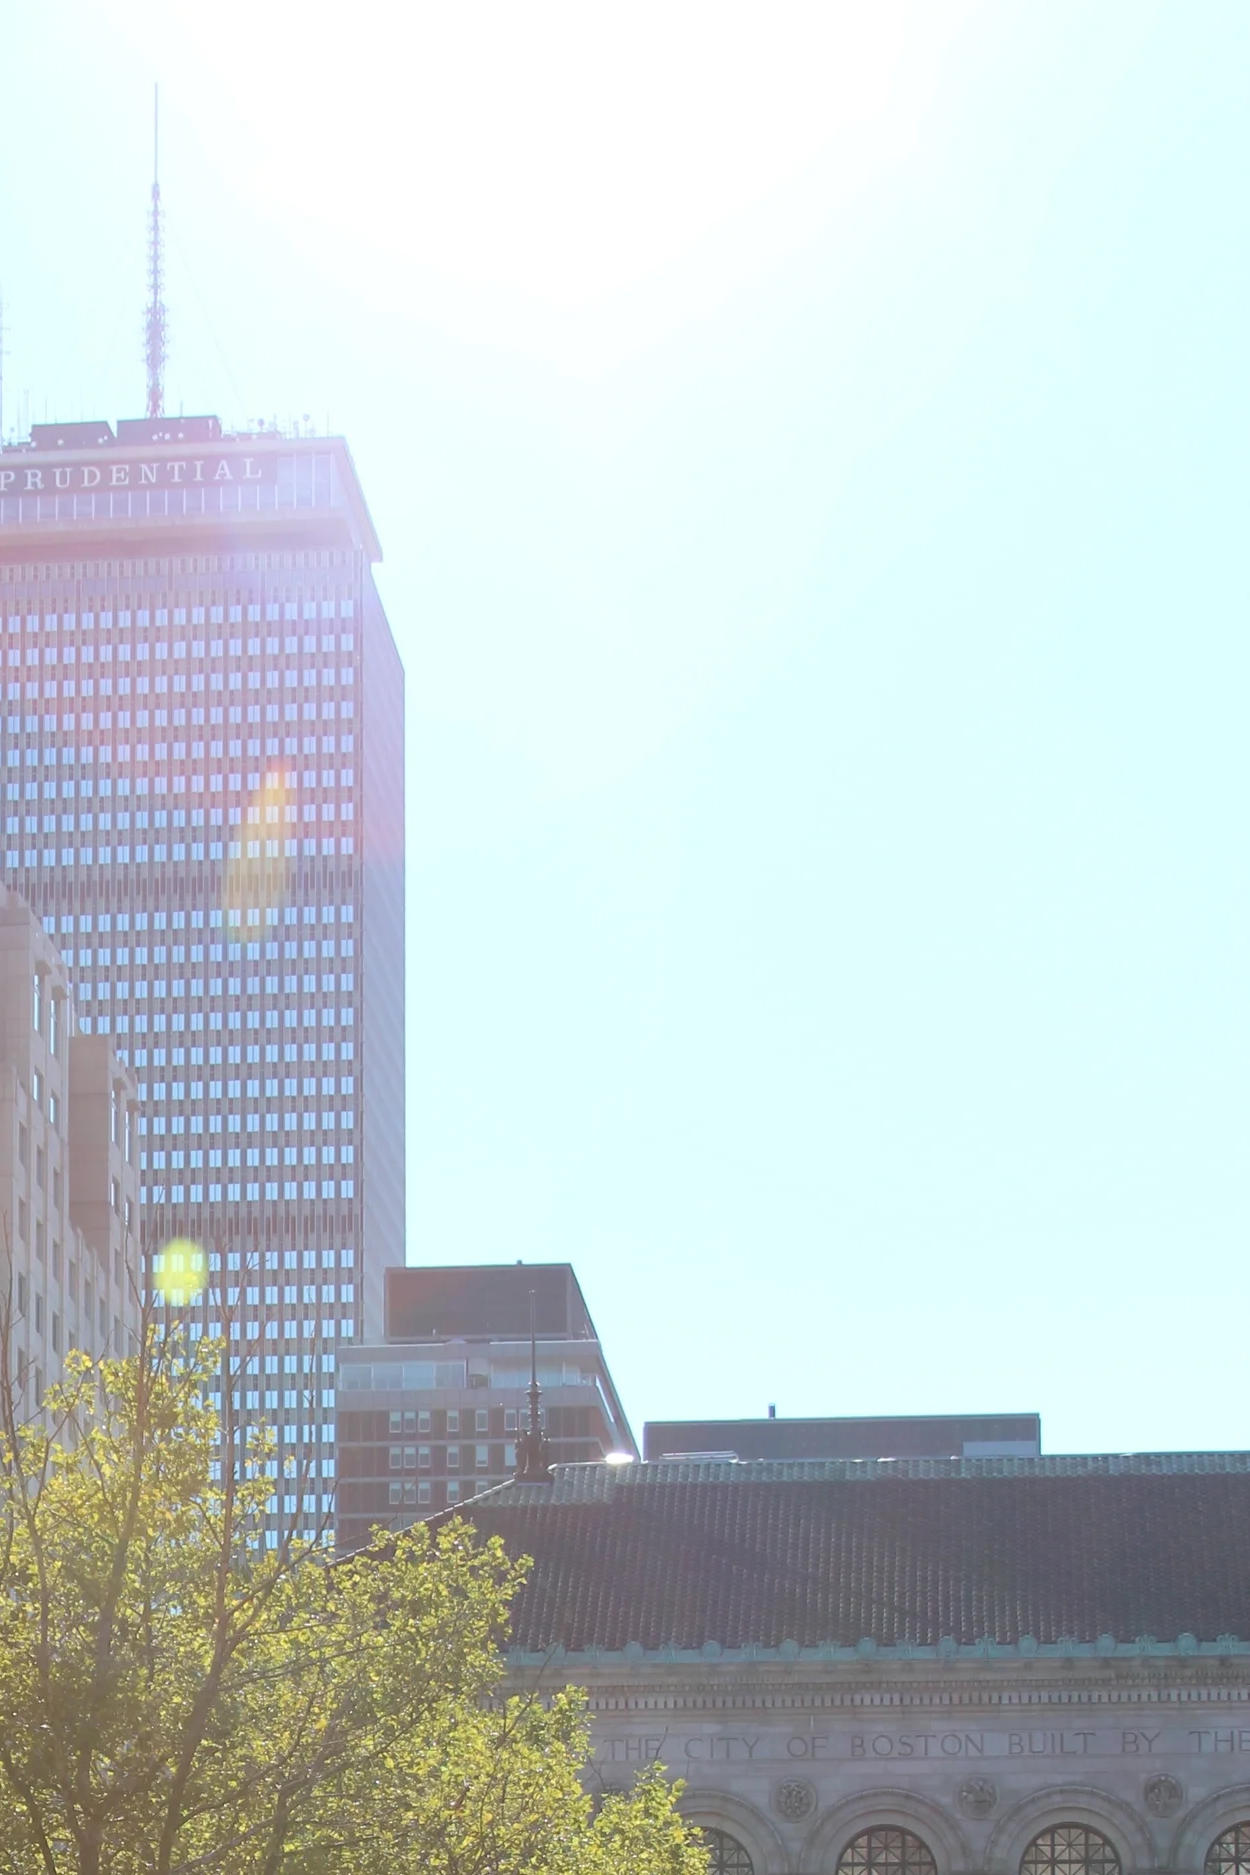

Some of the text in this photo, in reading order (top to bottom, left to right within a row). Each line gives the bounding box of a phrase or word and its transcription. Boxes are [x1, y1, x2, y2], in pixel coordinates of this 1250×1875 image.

[603, 1730, 1250, 1760] THE CITY OF BOSTON BUILT BY THE
